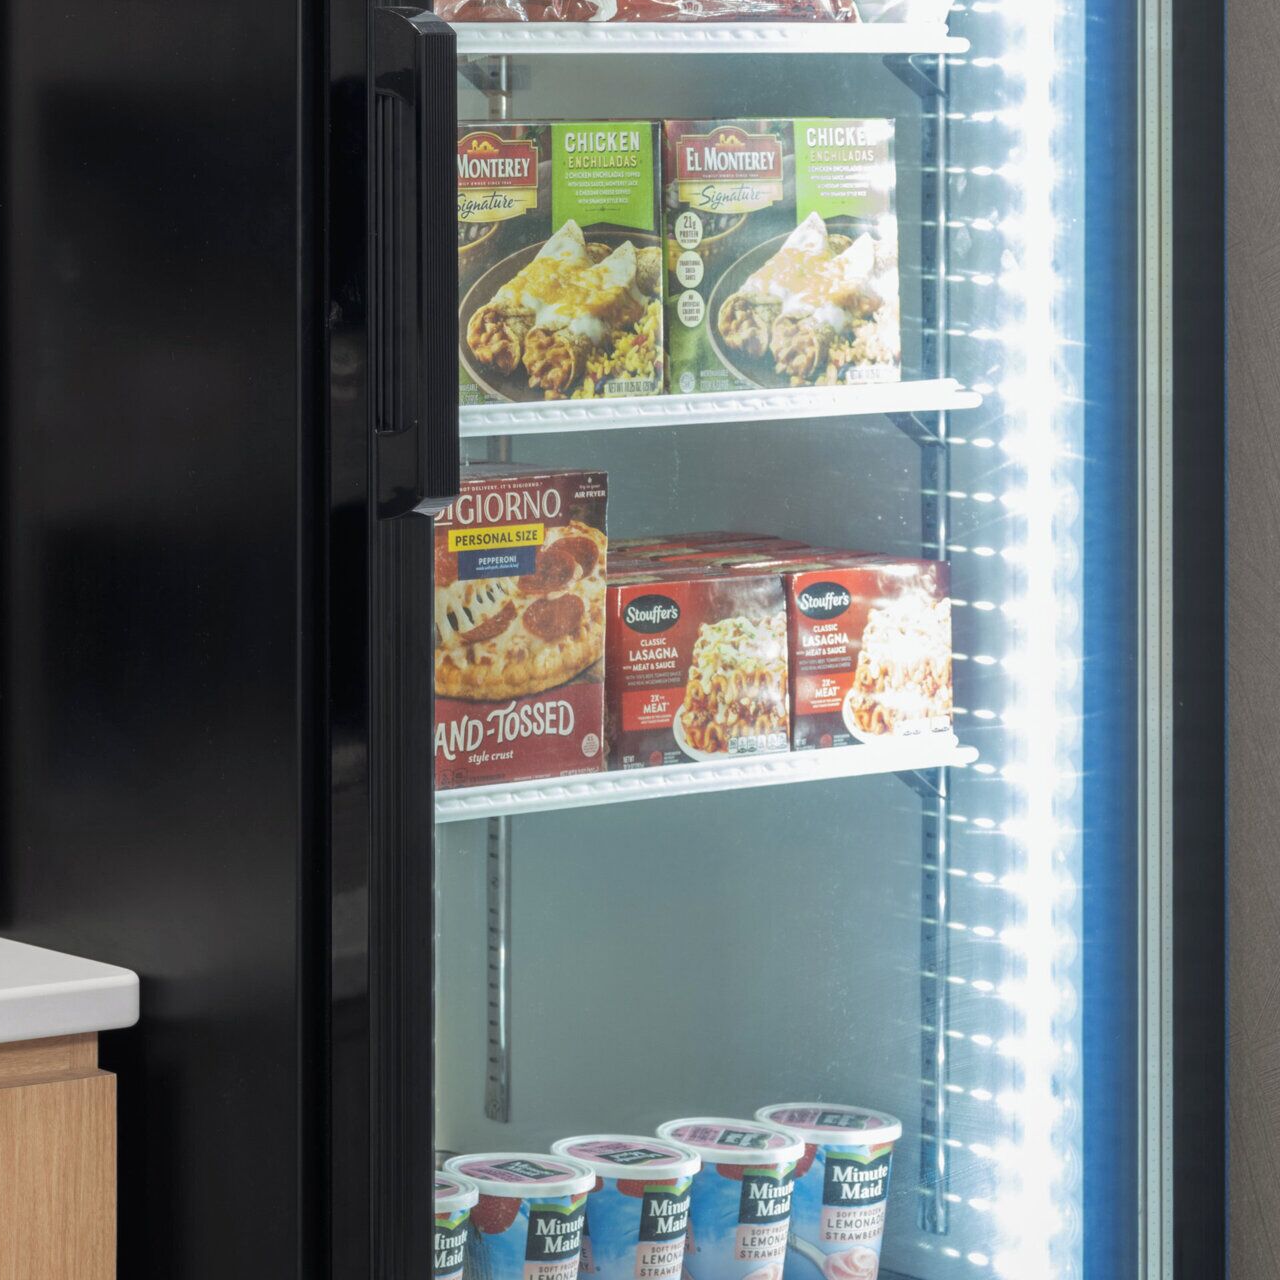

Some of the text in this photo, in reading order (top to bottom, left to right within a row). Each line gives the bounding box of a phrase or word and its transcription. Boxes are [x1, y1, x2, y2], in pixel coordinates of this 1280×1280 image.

[564, 131, 641, 153] CHICKEN
[568, 155, 638, 169] ENCHILADAS
[686, 146, 775, 171] EL MONTEREY
[811, 150, 875, 163] ENCHILADAS
[699, 185, 761, 209] Signature
[680, 230, 699, 238] PROTEIN
[586, 490, 606, 498] FRYER
[455, 530, 538, 547] PERSONAL SIZE
[478, 555, 517, 566] PEPPERONI
[799, 592, 850, 611] Stouffer's
[626, 605, 678, 623] Stouffer's
[813, 623, 838, 633] CLASSIC
[640, 637, 667, 648] CLASSIC
[802, 633, 849, 648] LASAGNA
[629, 647, 678, 662] LASAGNA
[805, 646, 847, 657] MEAT SAUCE
[632, 660, 676, 671] MEAT SAUCE
[468, 750, 514, 765] style crust
[832, 1164, 889, 1183] Minute
[840, 1179, 883, 1200] Maid
[755, 1195, 791, 1217] Maid
[656, 1214, 689, 1234] Maid
[751, 1229, 768, 1237] SOFT
[544, 1233, 581, 1254] Maid
[651, 1245, 670, 1254] SOFT
